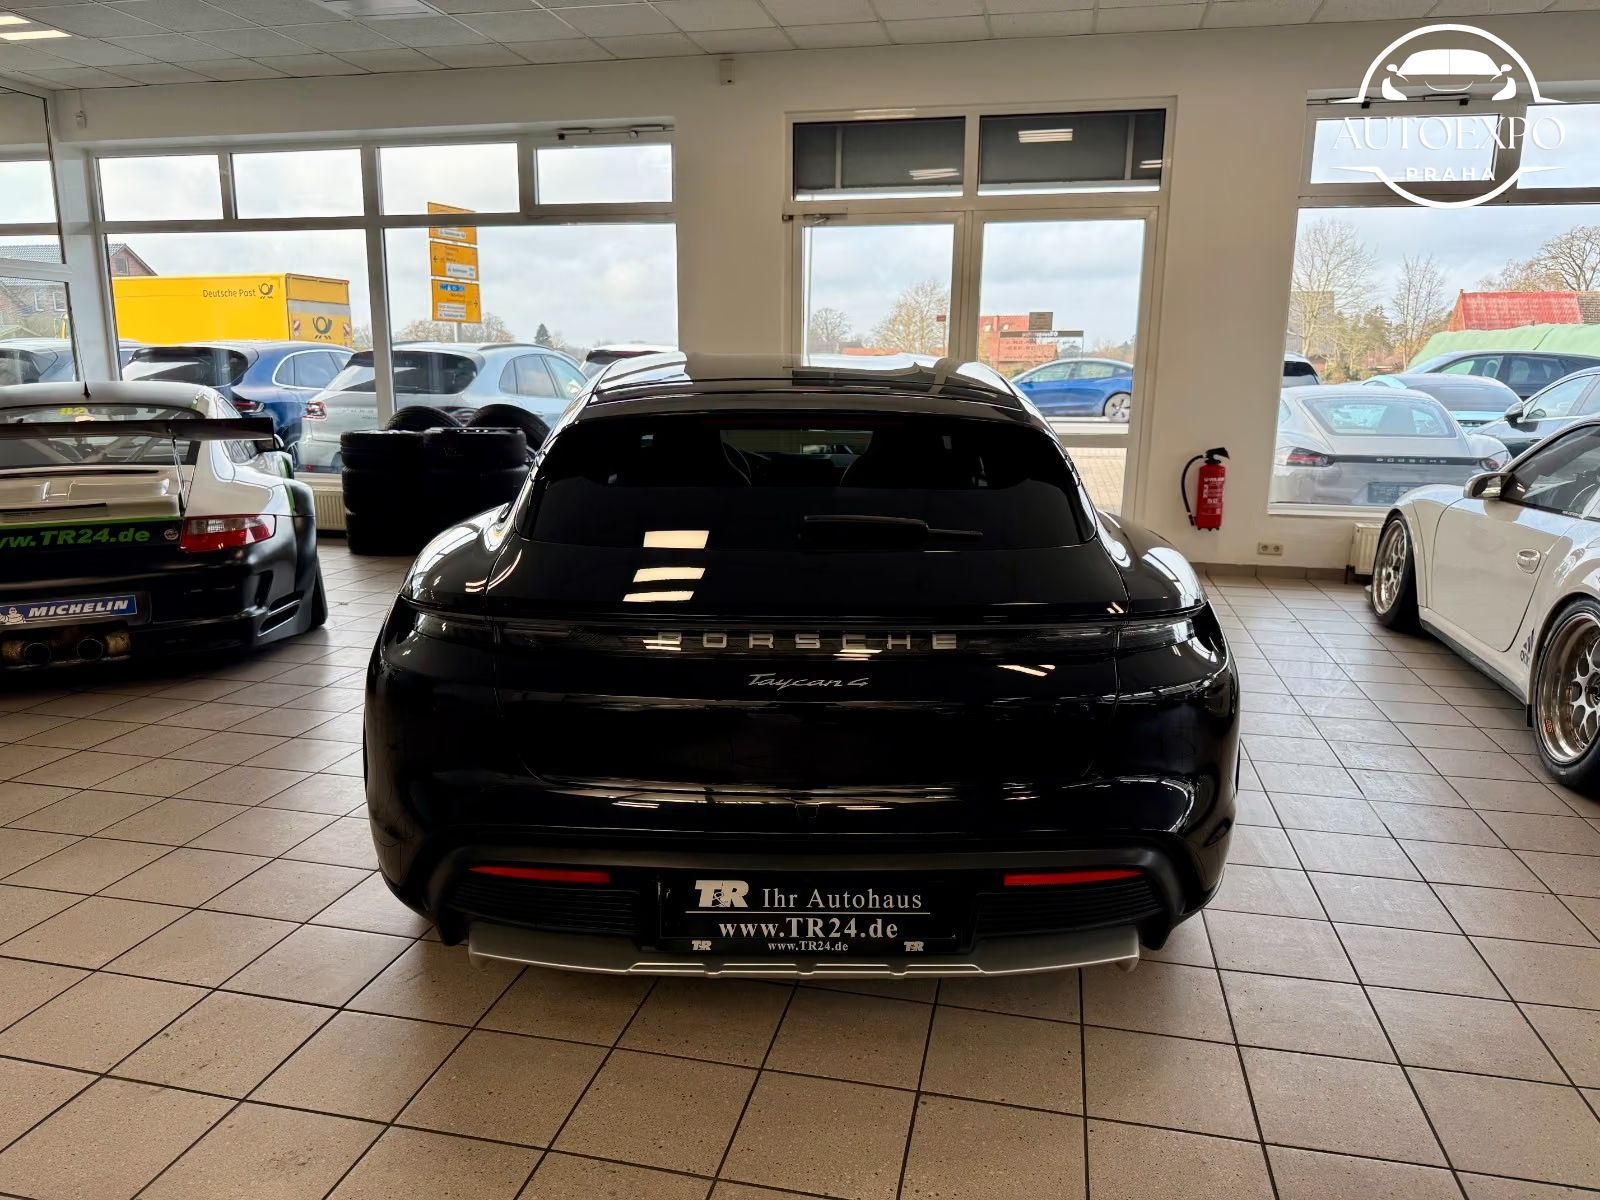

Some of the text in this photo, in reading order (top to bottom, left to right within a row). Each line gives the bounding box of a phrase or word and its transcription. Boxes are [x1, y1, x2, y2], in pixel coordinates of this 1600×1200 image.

[202, 288, 256, 298] Deutsche Post
[28, 599, 129, 618] MICHELIN
[656, 631, 957, 650] PORSCHE
[747, 672, 843, 691] Taycan
[762, 887, 798, 909] Ihr
[806, 888, 922, 909] Autohaus
[718, 917, 898, 938] www.TR24.de
[768, 940, 849, 952] www.TR24.de
